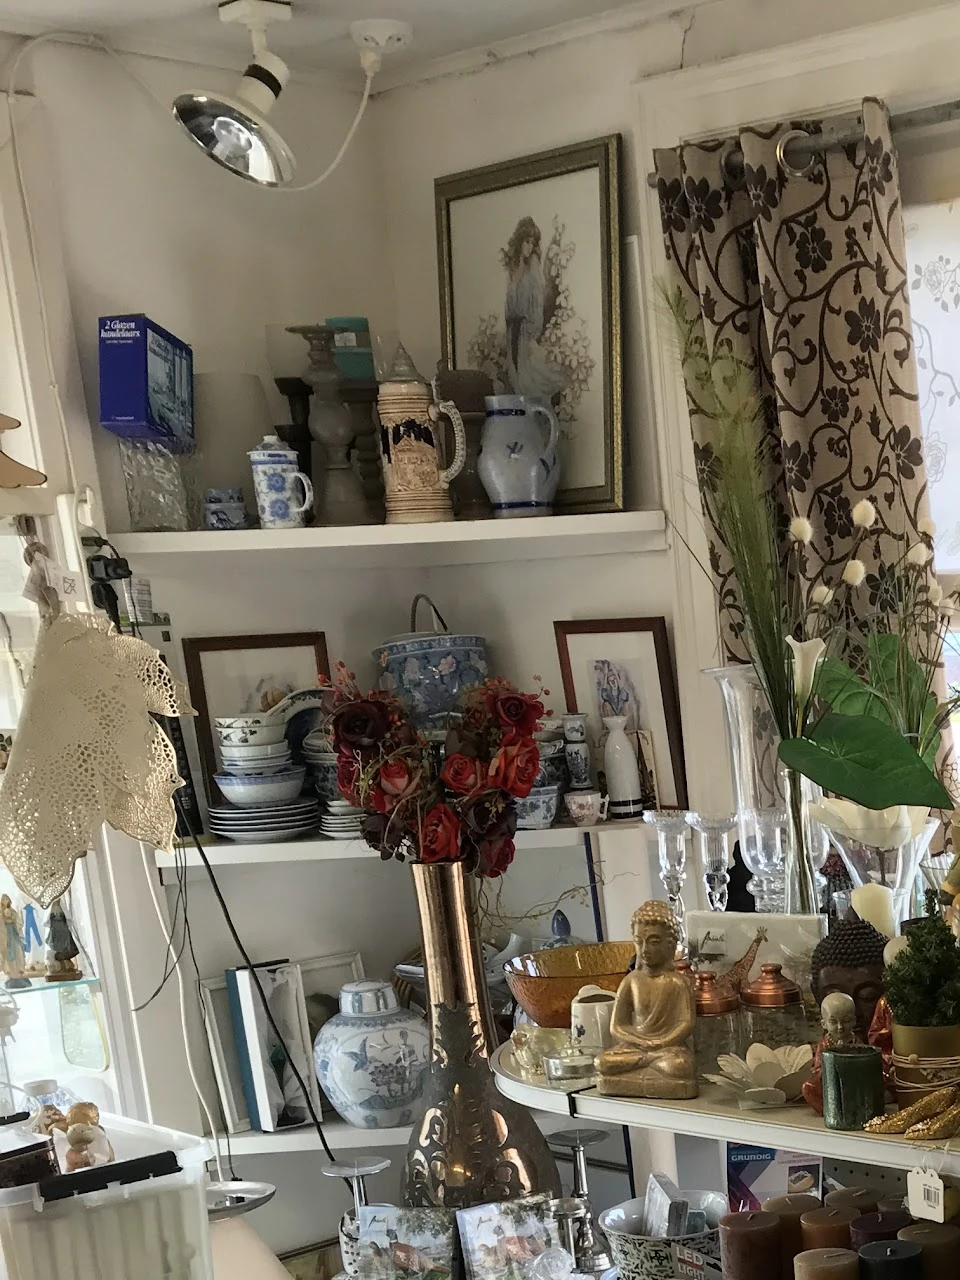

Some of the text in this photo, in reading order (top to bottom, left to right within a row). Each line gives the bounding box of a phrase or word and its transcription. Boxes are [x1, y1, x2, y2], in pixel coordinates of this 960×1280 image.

[104, 320, 136, 329] 2 Glazen
[731, 1153, 771, 1161] GRUNDIG
[676, 1246, 704, 1265] LED
[678, 1263, 705, 1280] LIGHT
